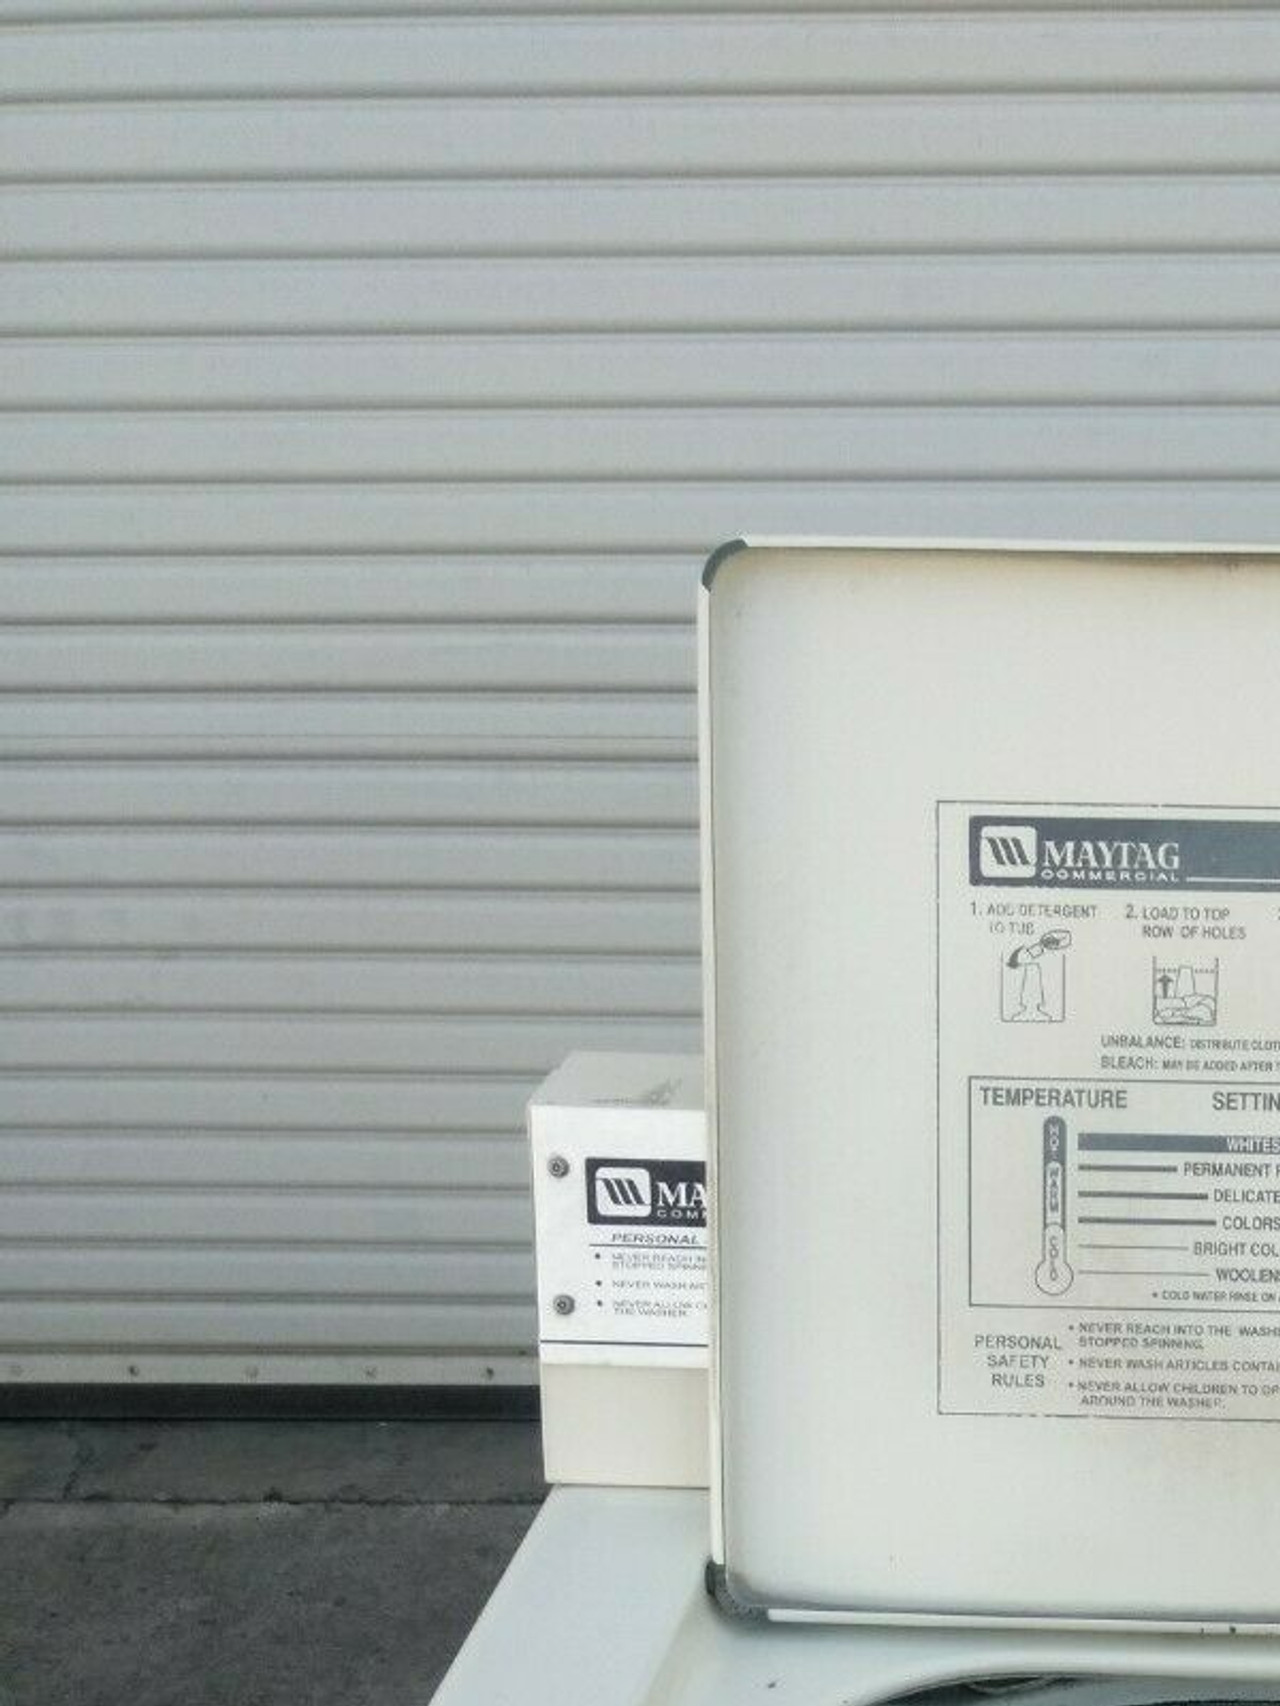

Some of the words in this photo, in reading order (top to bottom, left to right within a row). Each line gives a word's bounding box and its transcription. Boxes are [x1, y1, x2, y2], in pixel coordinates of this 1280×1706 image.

[1042, 840, 1180, 870] MAYTAG
[1040, 870, 1180, 882] COMMERCIAL
[1126, 904, 1138, 918] 2.
[1143, 906, 1178, 920] LOAD
[1183, 907, 1200, 920] TO
[1204, 907, 1230, 921] TOP
[1143, 926, 1174, 939] ROW
[1181, 926, 1198, 939] OF
[1202, 926, 1246, 940] HOLES
[1101, 1035, 1185, 1050] UNBALANCE:
[1101, 1056, 1158, 1070] BLEACH:
[980, 1087, 1127, 1109] TEMPERATURE
[1226, 1137, 1280, 1153] WHITES
[1184, 1162, 1269, 1177] PERMANENT
[611, 1233, 700, 1245] PERSONAL
[1193, 1242, 1246, 1257] BRIGHT
[1079, 1322, 1122, 1334] NEVER
[1126, 1323, 1170, 1335] REACH
[1173, 1324, 1204, 1336] INTO
[1207, 1325, 1232, 1336] THE
[975, 1335, 1062, 1349] PERSONAL
[1079, 1337, 1138, 1348] STOPPED
[987, 1355, 1050, 1369] SAFETY
[1079, 1358, 1122, 1369] NEVER
[1126, 1358, 1164, 1370] WASH
[1166, 1359, 1228, 1371] ARTICLES
[991, 1374, 1045, 1388] RULES
[1078, 1381, 1121, 1392] NEVER
[1124, 1382, 1169, 1393] ALLOW
[1173, 1382, 1238, 1394] CHILDREN
[1242, 1384, 1258, 1395] TO
[1080, 1395, 1135, 1406] AROUND
[1140, 1396, 1163, 1407] THE
